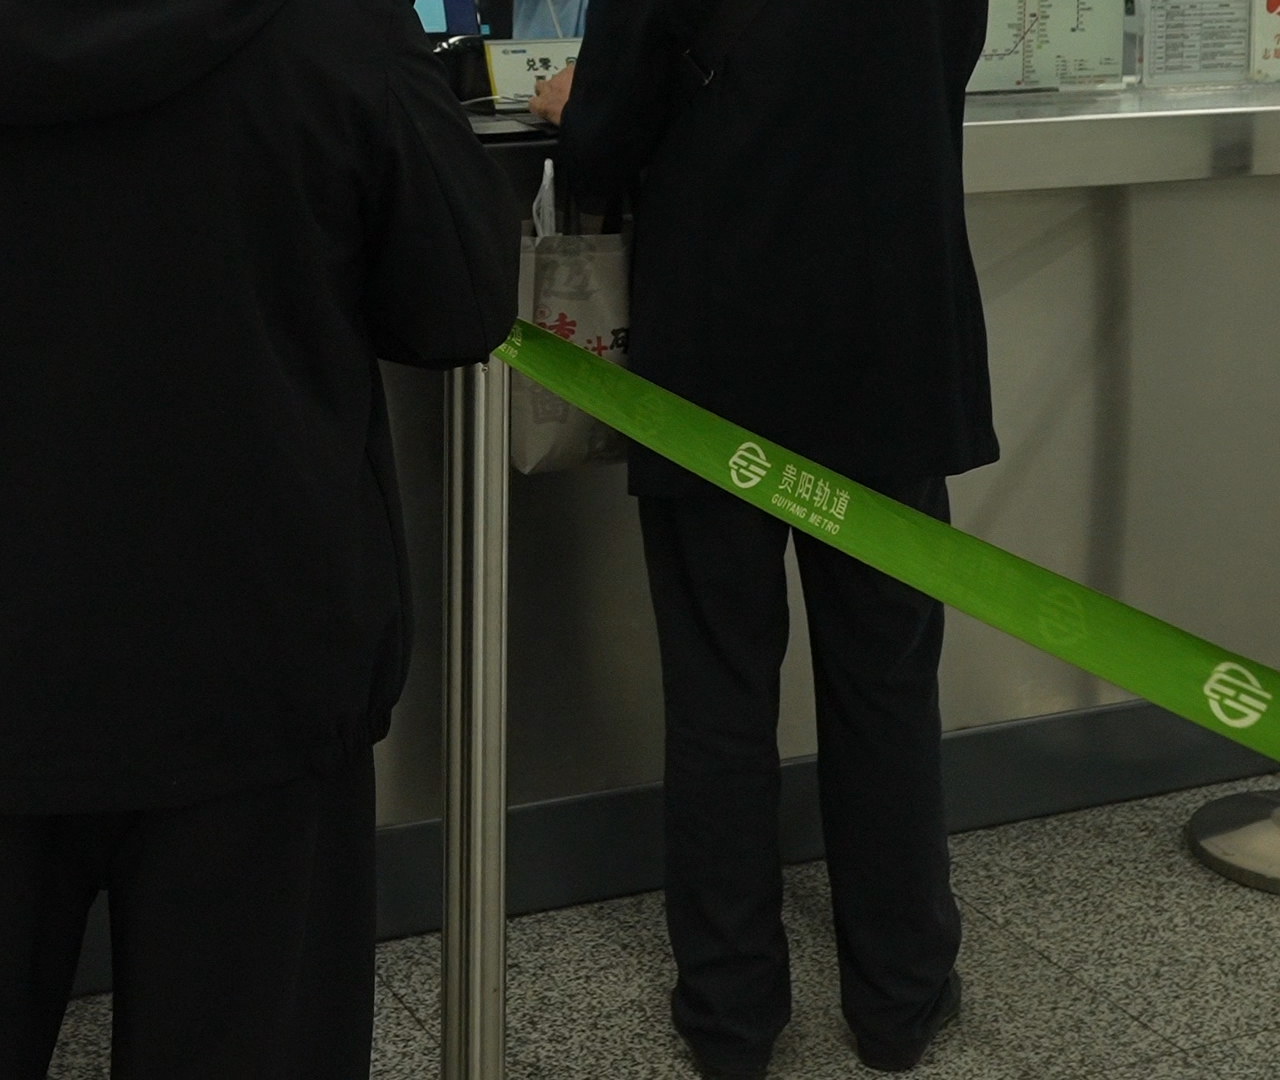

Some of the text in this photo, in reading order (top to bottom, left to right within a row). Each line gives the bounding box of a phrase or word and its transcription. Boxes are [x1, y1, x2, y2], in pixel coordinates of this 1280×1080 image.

[771, 493, 841, 536] GUIYANG METRO
[778, 463, 851, 521] 贵阳轨道
